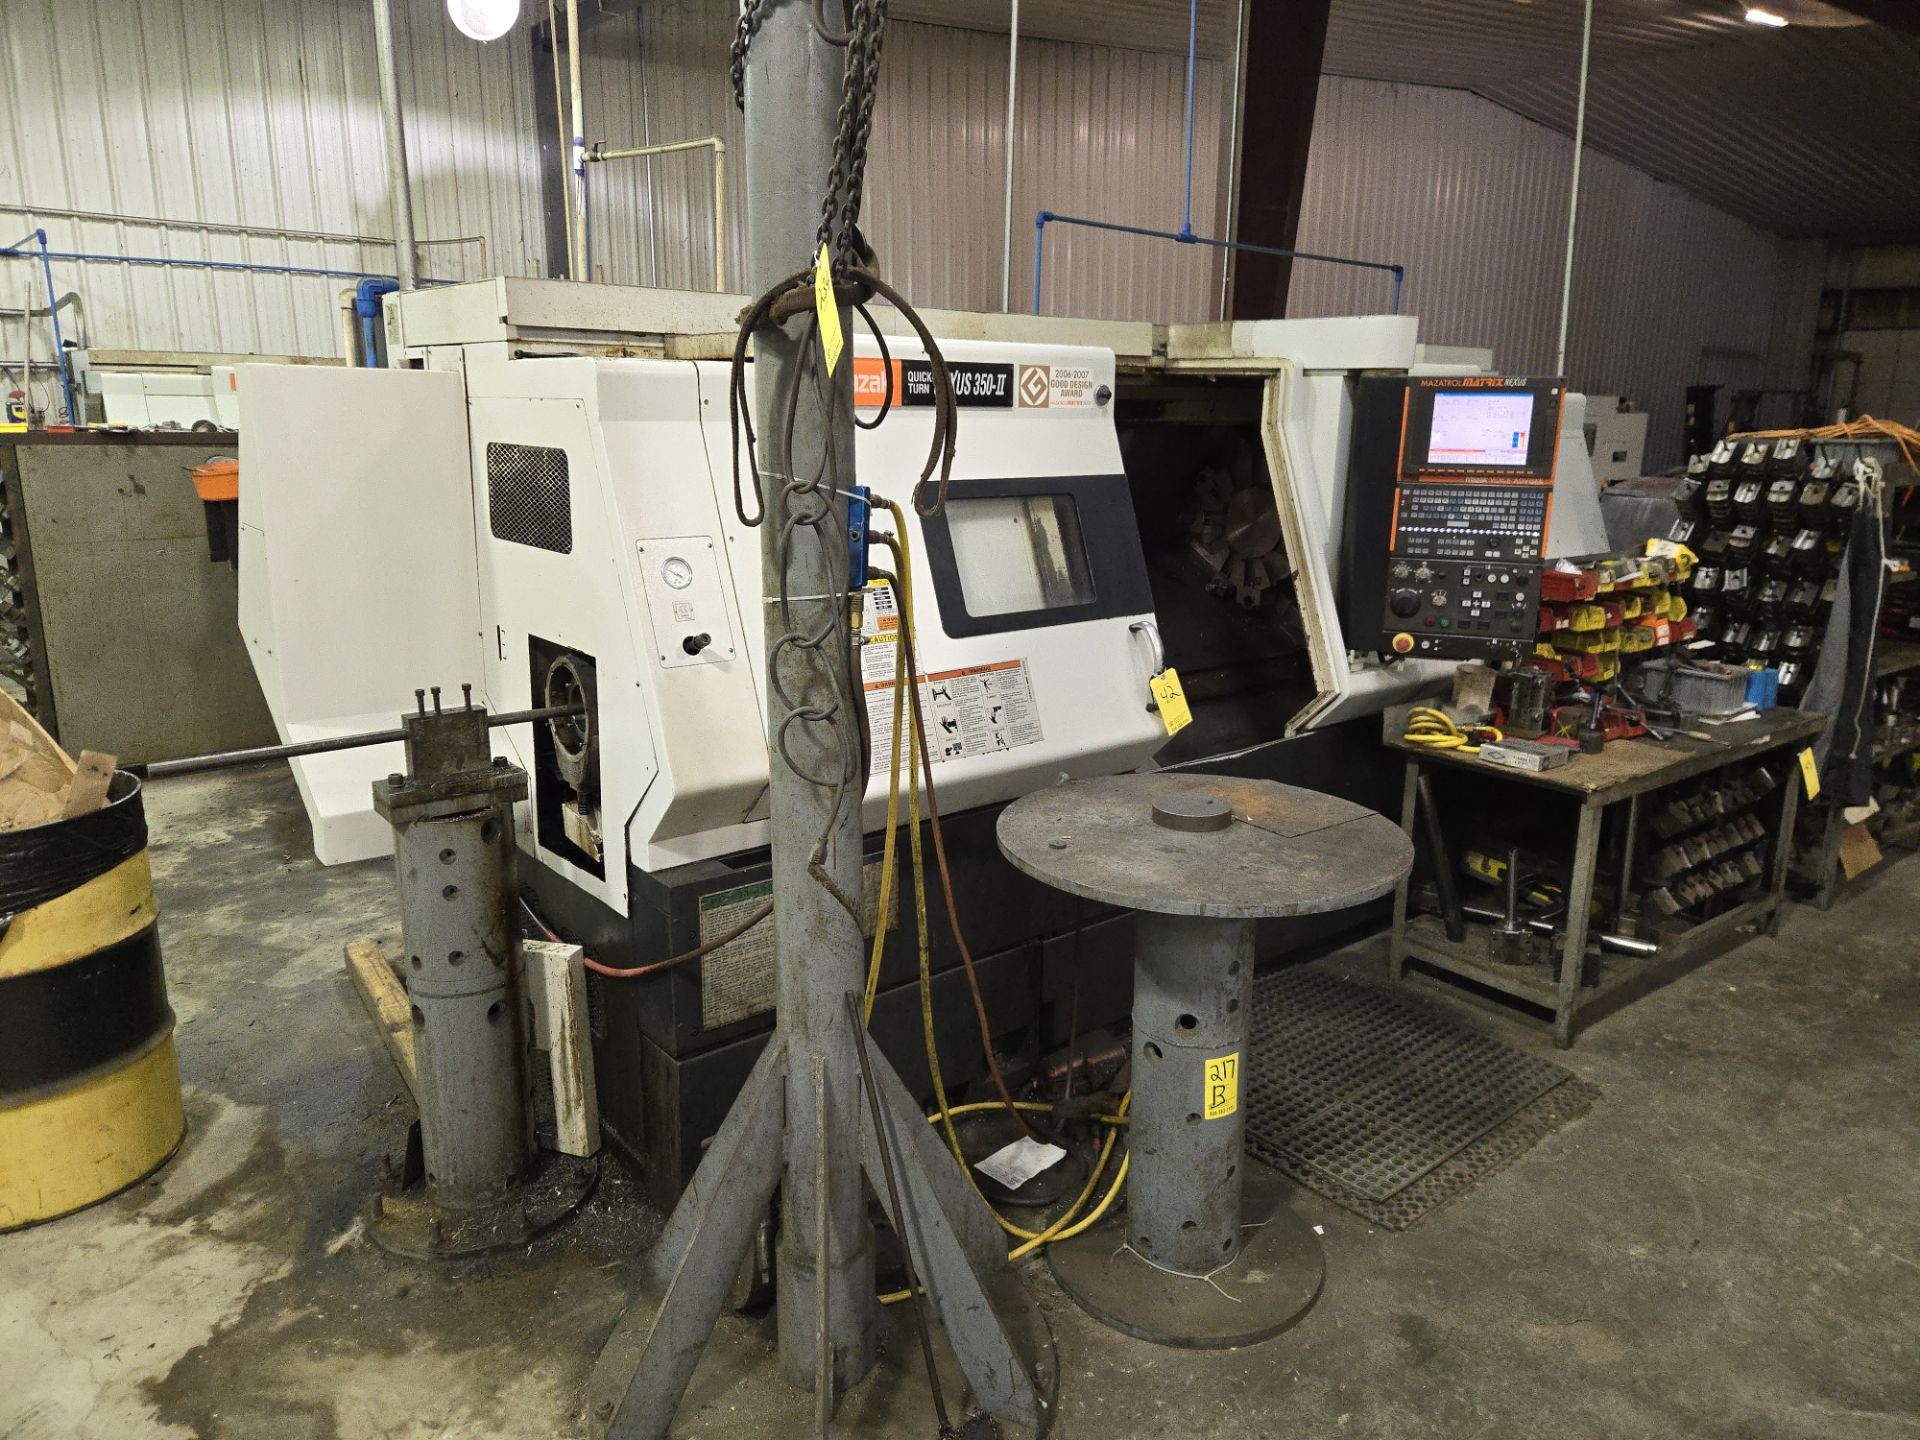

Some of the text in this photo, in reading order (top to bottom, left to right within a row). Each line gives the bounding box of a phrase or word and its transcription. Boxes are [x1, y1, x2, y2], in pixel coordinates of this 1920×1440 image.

[907, 370, 933, 383] QUICK
[908, 383, 930, 394] TURN
[1050, 379, 1093, 390] GOOD DESIGN
[1421, 379, 1462, 387] MAZATROL
[1060, 389, 1083, 398] AWARD
[1160, 685, 1181, 701] 42
[1209, 1059, 1235, 1081] 217
[1211, 1085, 1226, 1108] B
